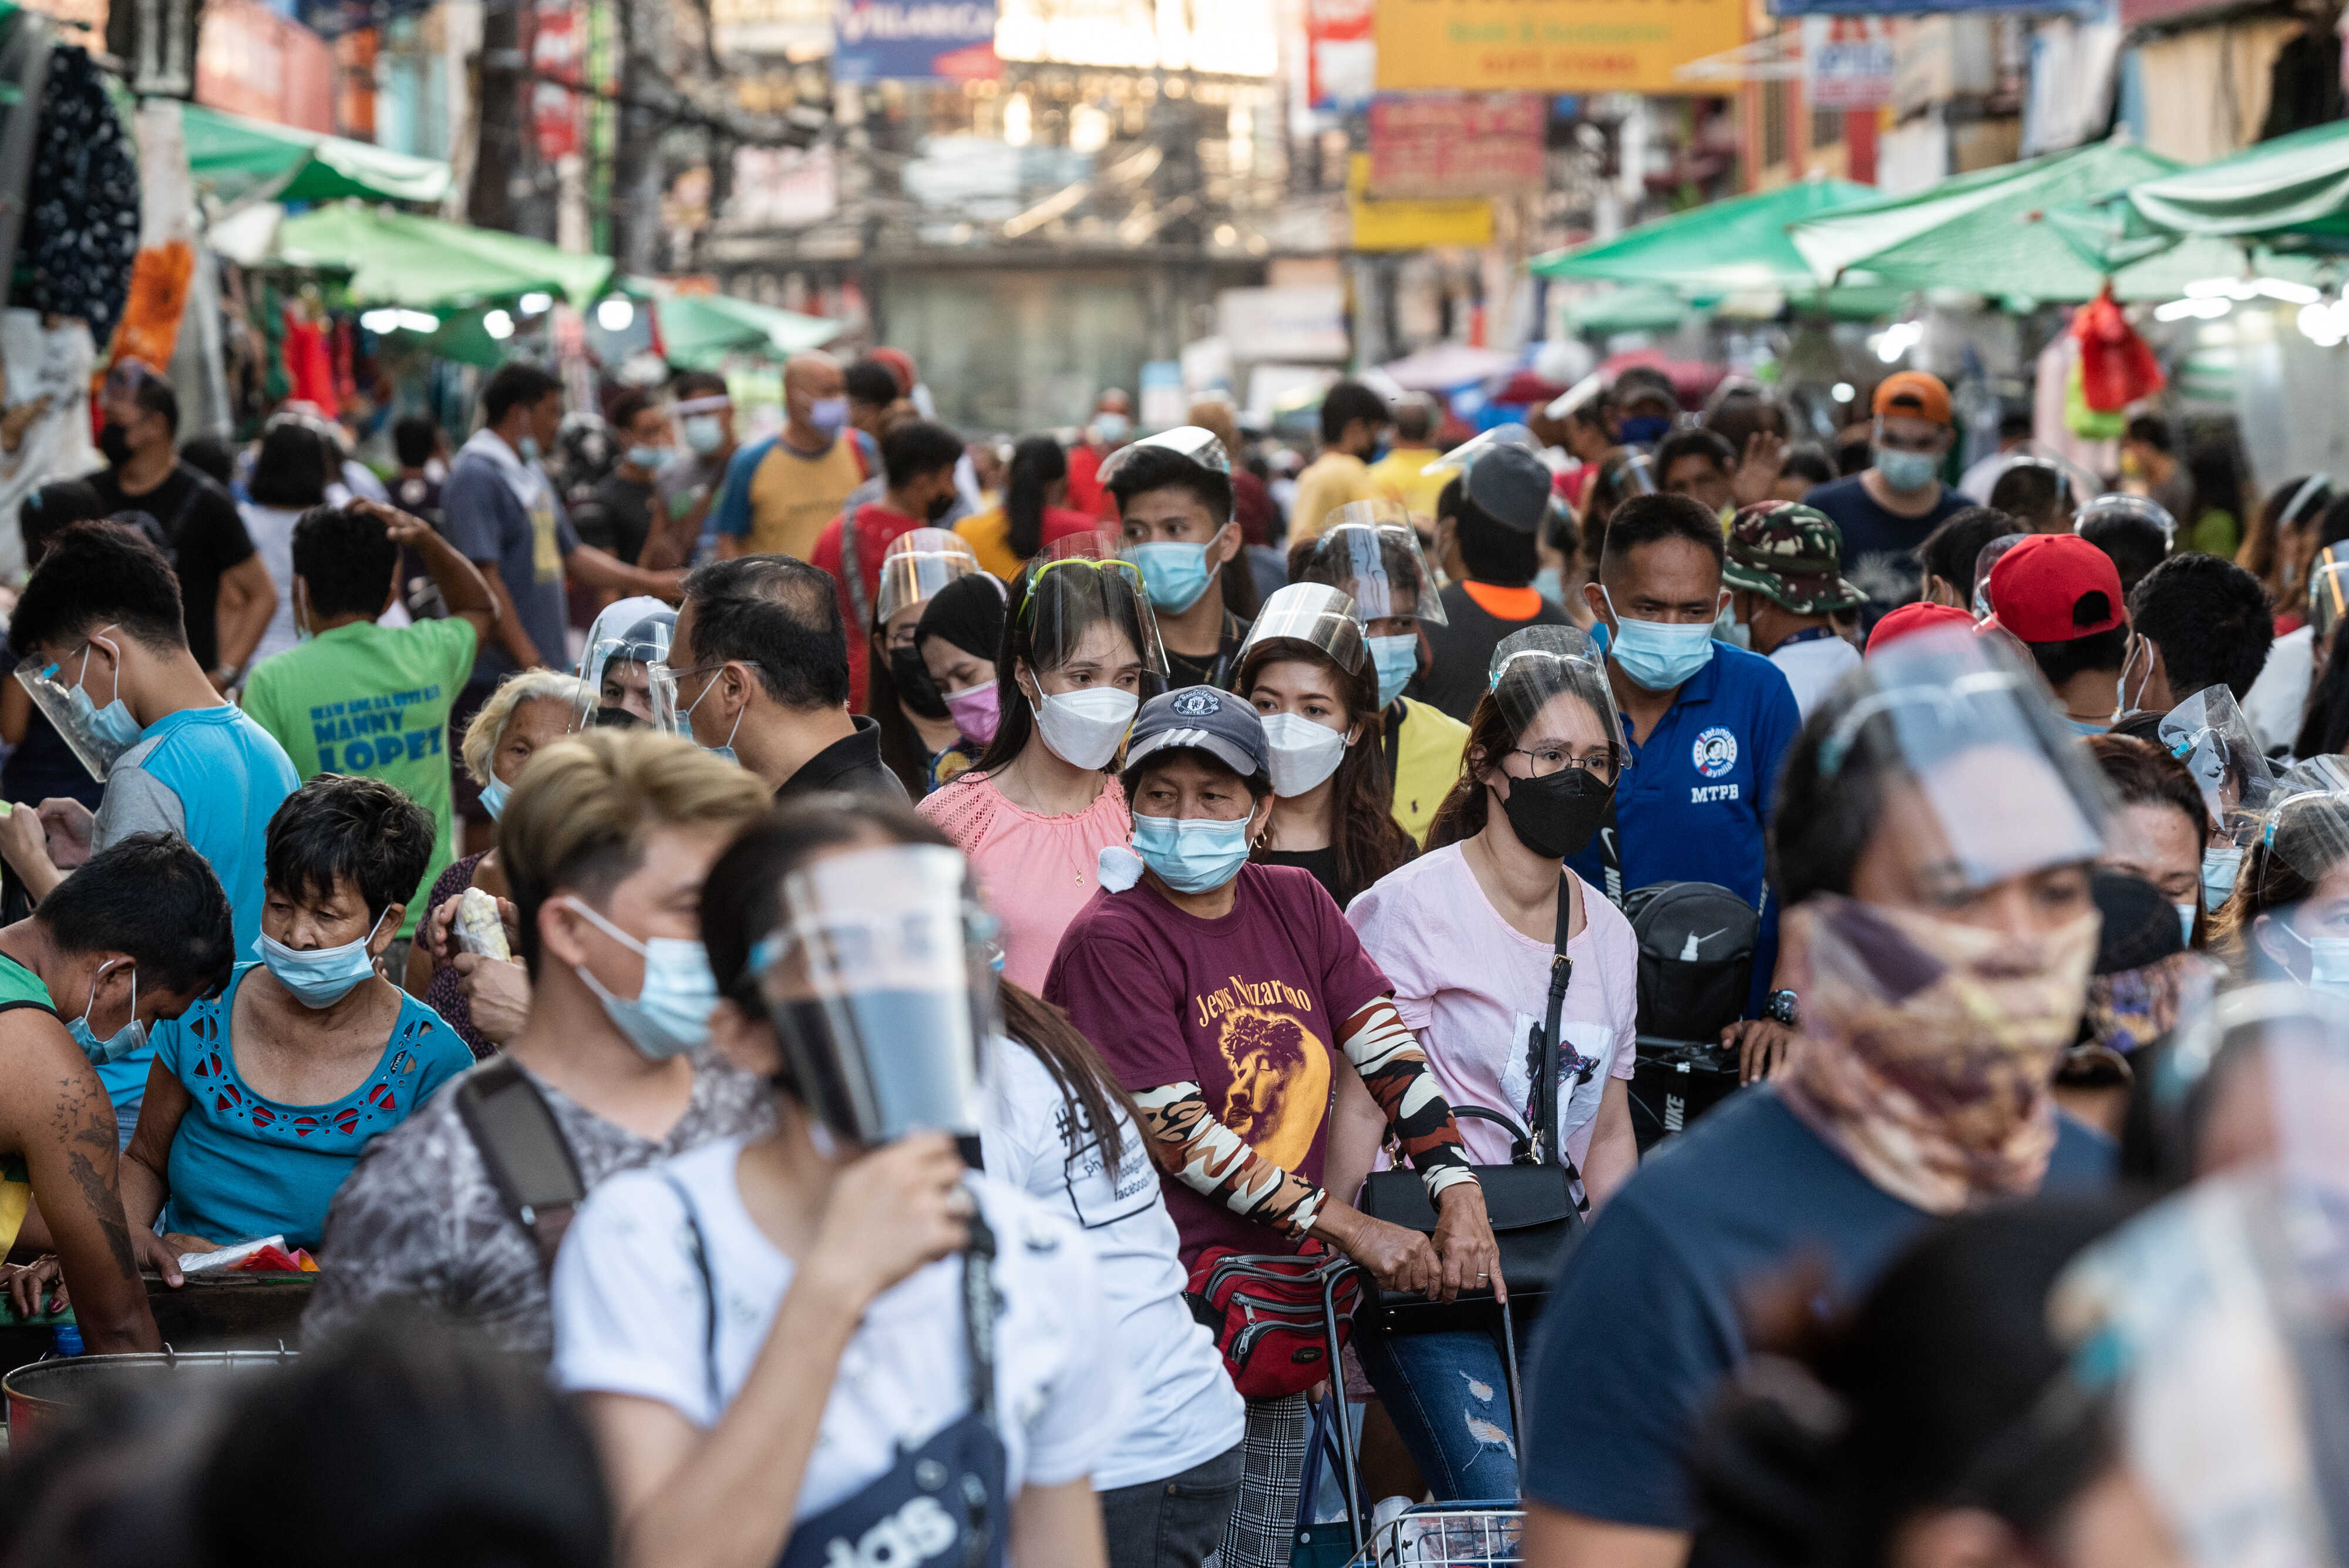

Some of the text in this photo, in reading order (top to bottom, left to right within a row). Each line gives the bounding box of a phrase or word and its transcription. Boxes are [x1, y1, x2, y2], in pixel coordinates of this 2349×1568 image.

[1182, 689, 1215, 704] MANCHESTER
[314, 709, 404, 745] MANNY
[1697, 726, 1732, 743] Batang
[318, 724, 442, 774] LOPEZ
[1691, 783, 1739, 804] MTPB
[1196, 987, 1235, 1027] Jesus
[1664, 1093, 1685, 1131] NIKE
